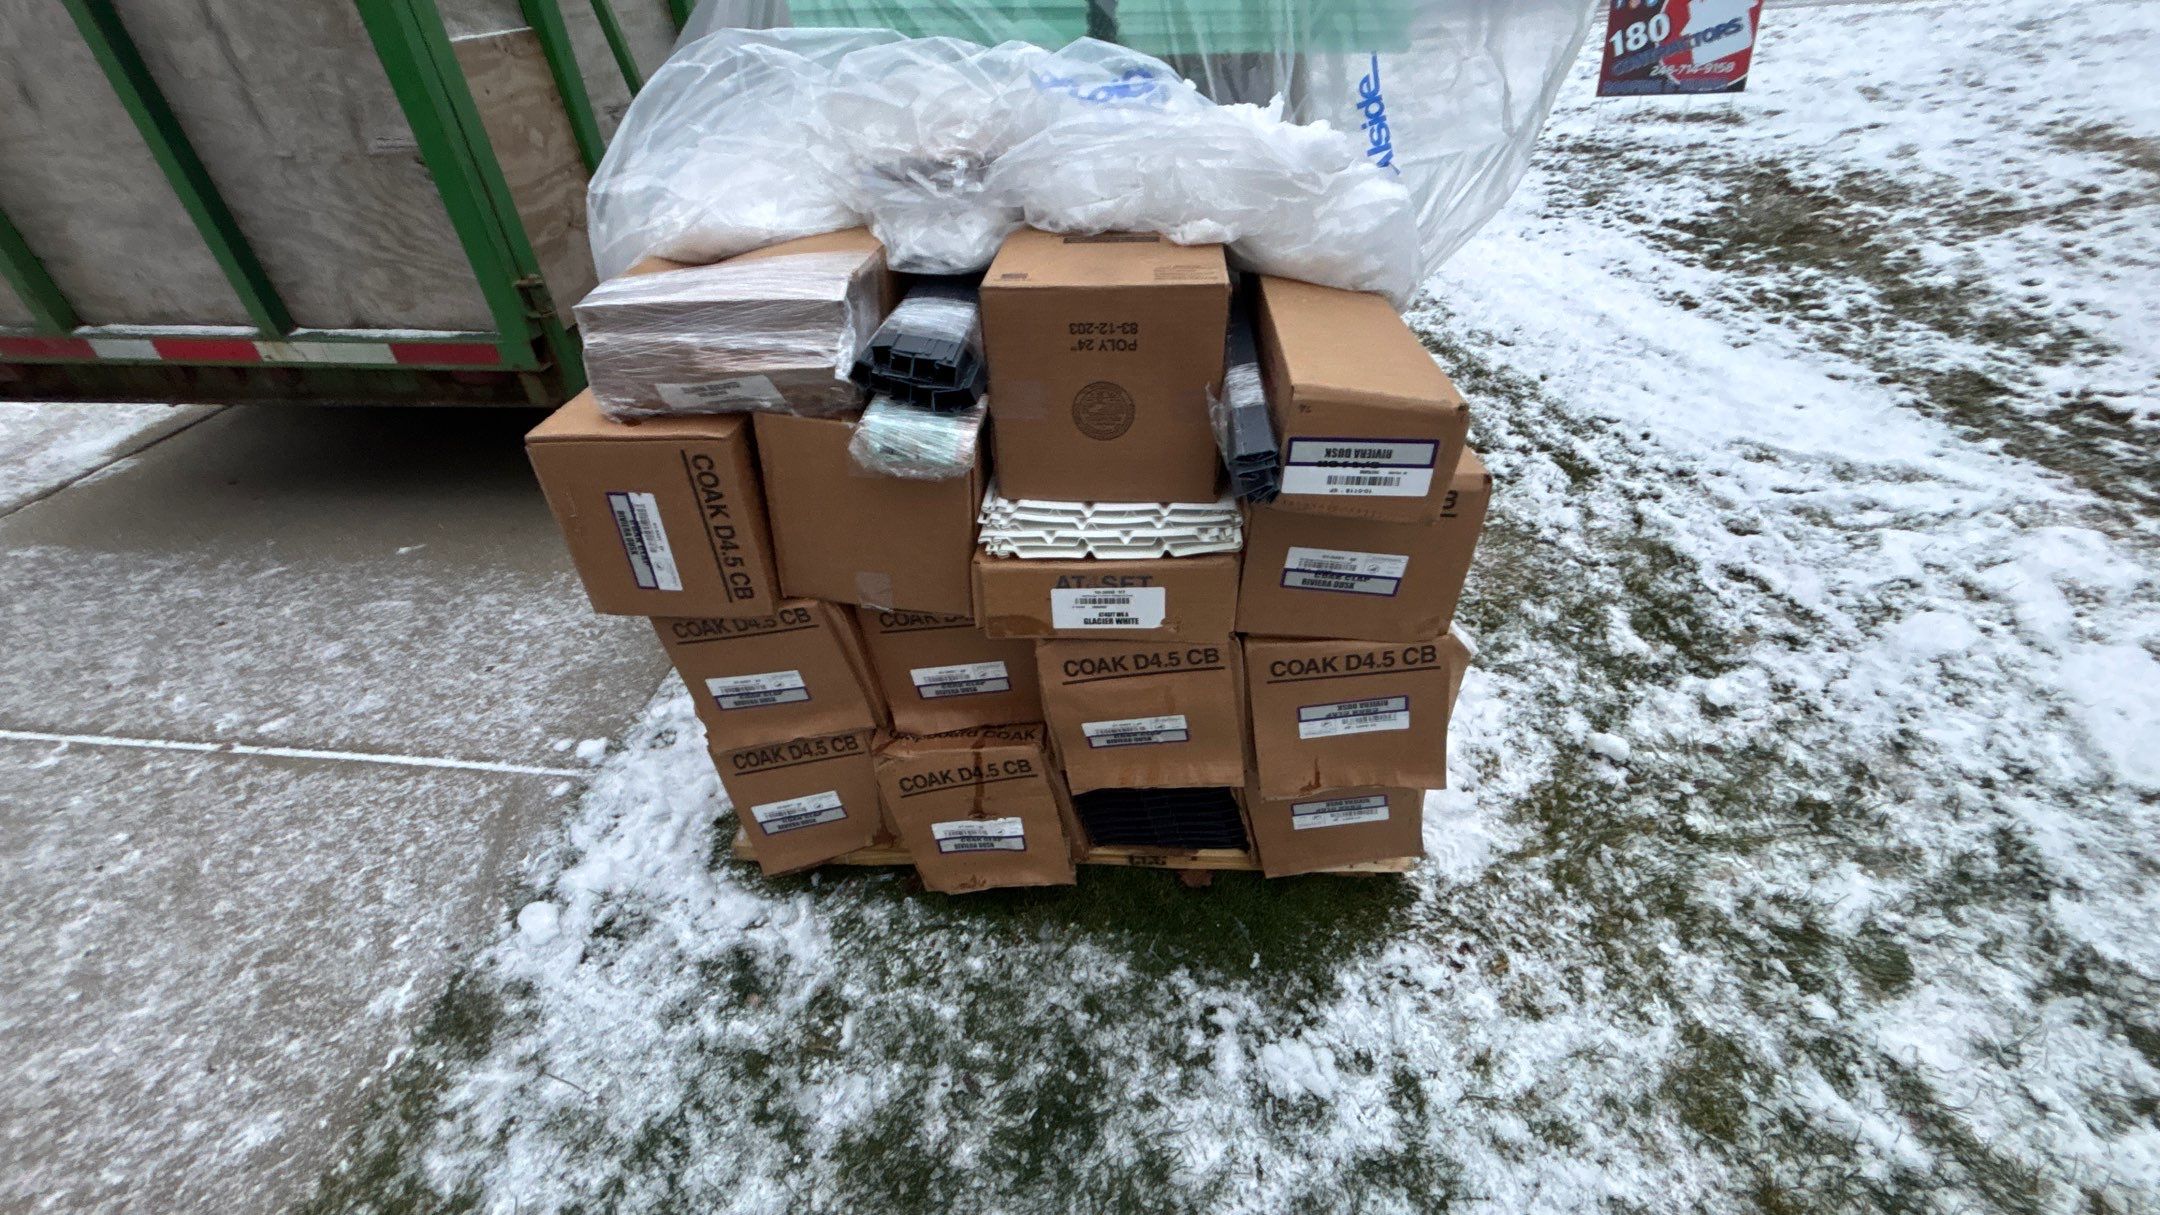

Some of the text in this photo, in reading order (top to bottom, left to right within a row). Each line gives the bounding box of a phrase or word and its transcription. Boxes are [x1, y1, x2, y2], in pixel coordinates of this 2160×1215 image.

[1609, 13, 1670, 57] 180
[1099, 339, 1137, 351] POLY
[1324, 447, 1393, 459] RIVIERA DUSK
[691, 454, 754, 600] COAK D4.5 CB
[672, 617, 730, 638] COAK
[779, 607, 811, 625] CB
[1063, 647, 1220, 677] COAK D4.5 CB
[1269, 645, 1437, 677] COAK D4.5 CB
[733, 736, 859, 769] COAK D4.5 CB
[899, 759, 1032, 792] COAK D4.5 CB
